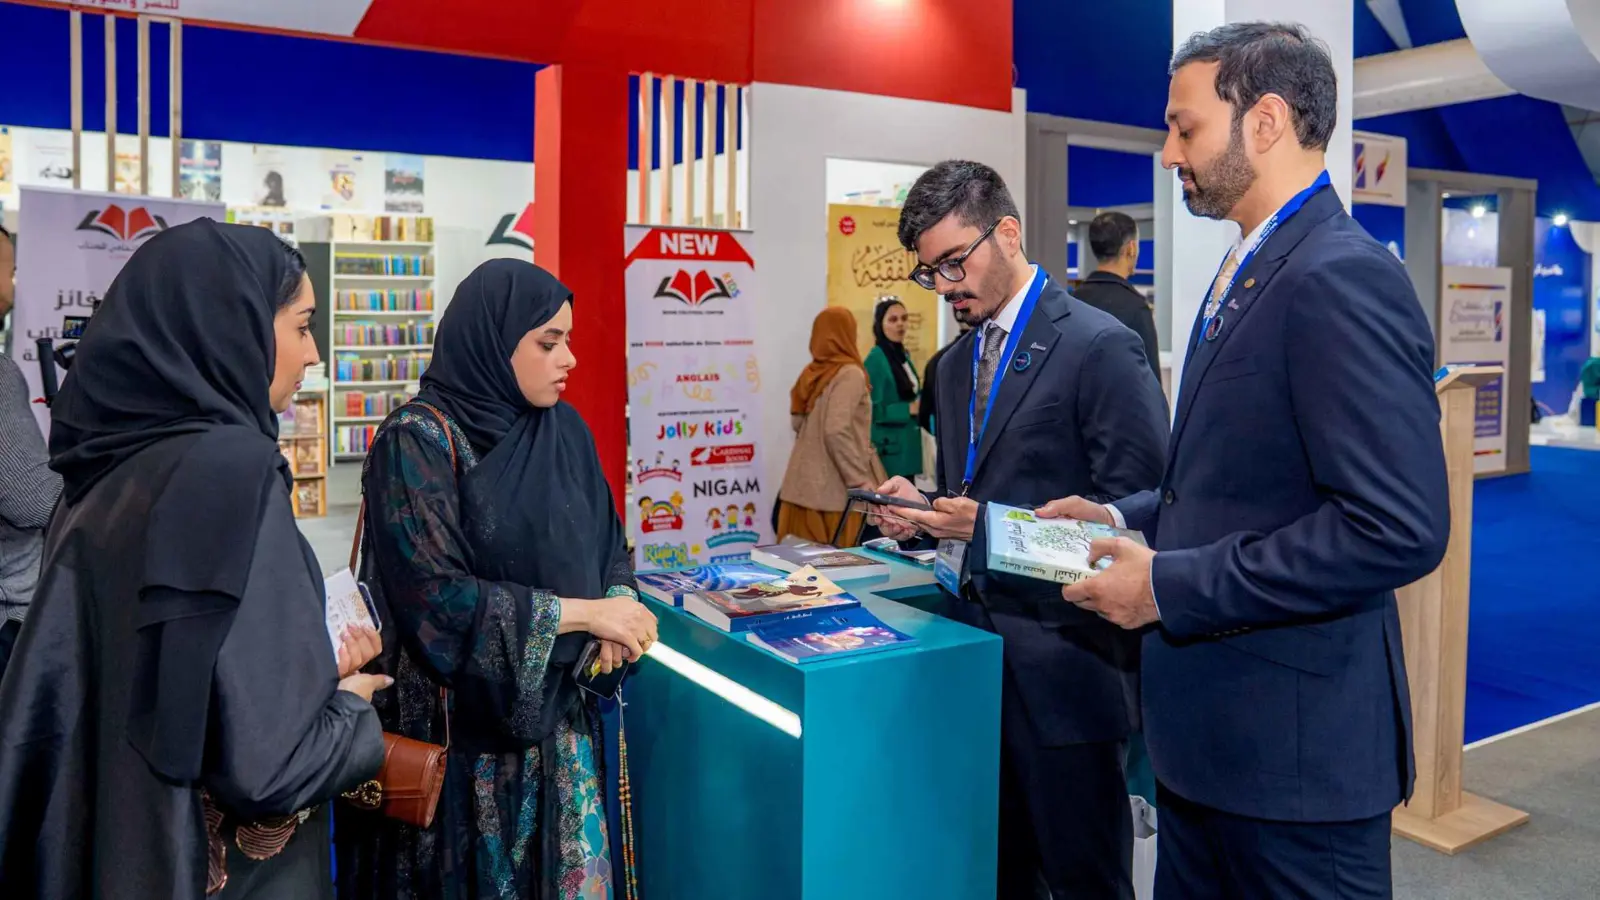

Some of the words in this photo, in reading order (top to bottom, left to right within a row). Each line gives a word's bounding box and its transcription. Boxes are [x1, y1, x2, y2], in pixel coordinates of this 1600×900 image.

[659, 232, 719, 256] NEW
[676, 373, 720, 383] ANGLAIS
[693, 477, 760, 498] NIGAM
[1054, 569, 1082, 582] أشجار
